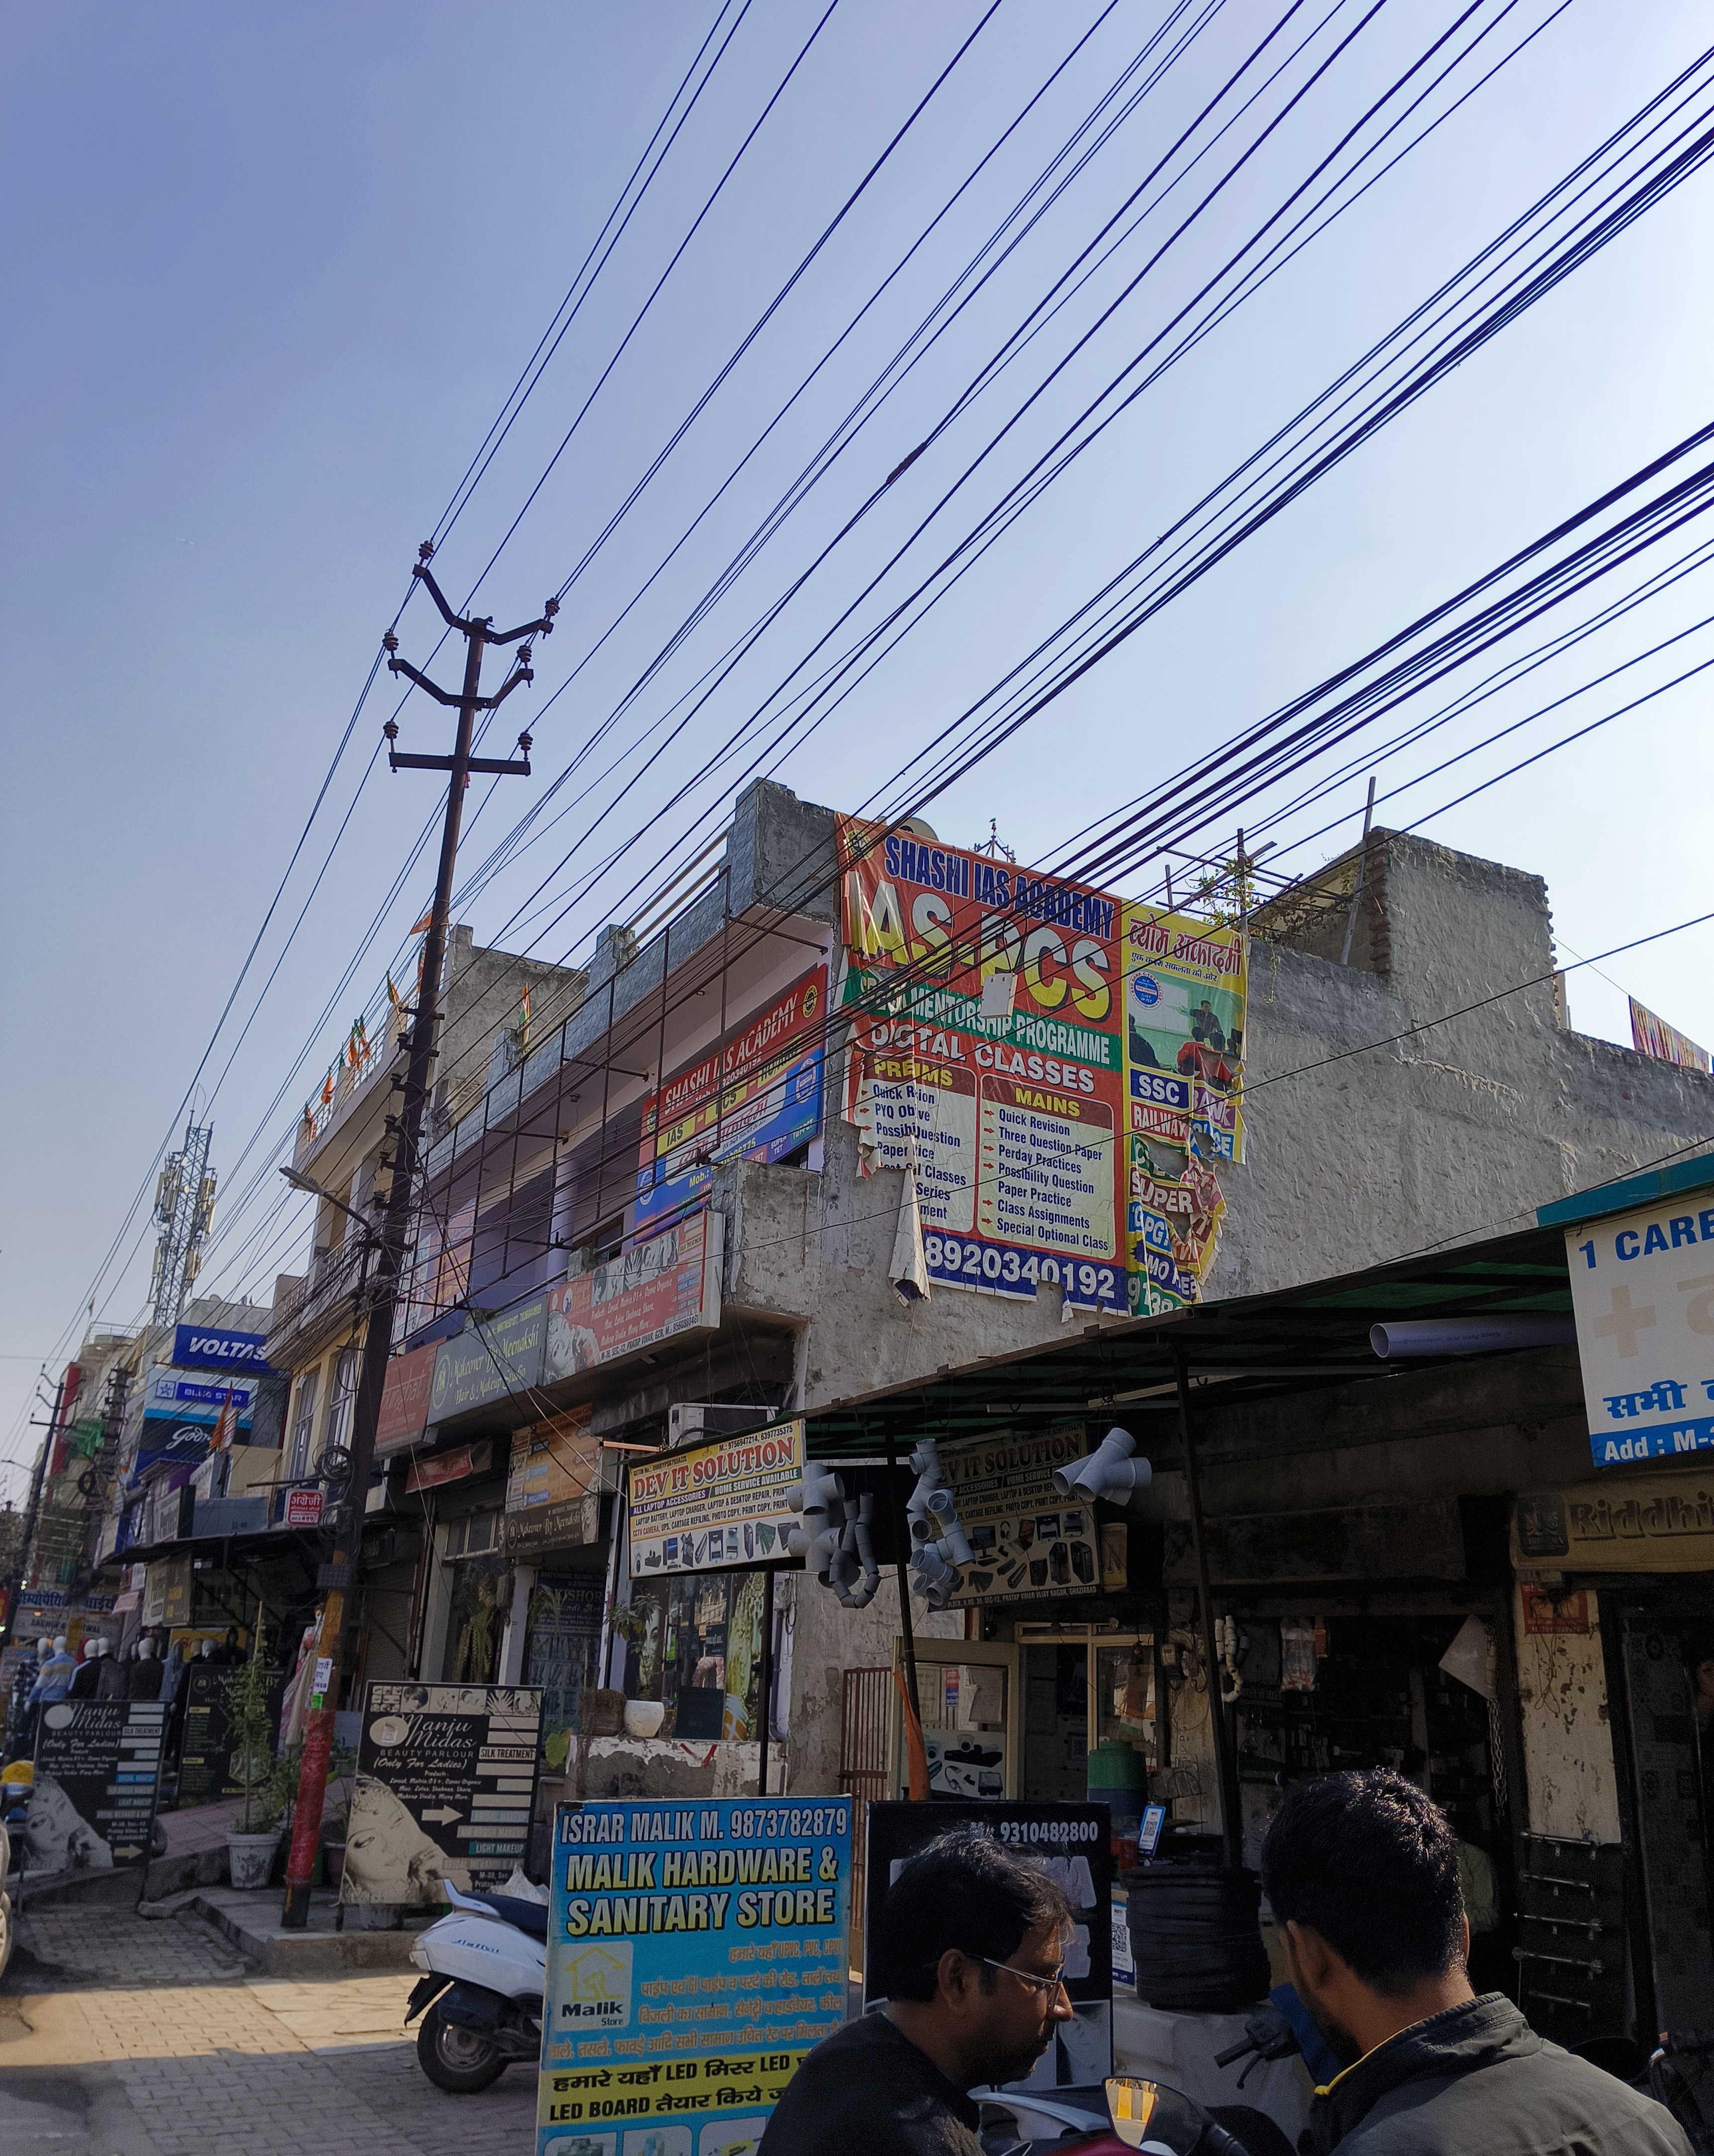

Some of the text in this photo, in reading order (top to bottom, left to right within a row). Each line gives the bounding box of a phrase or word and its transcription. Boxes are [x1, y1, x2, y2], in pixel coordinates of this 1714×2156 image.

[885, 835, 968, 899] SHASHI
[973, 862, 1011, 910] IAS
[1015, 875, 1114, 941] ACADEMY
[735, 993, 798, 1067] ACADEMY
[1016, 1014, 1110, 1066] PROGRAMME
[975, 1041, 1094, 1095] CLASSES
[1015, 1087, 1080, 1117] MAINS
[1139, 1074, 1180, 1104] SSC
[875, 1103, 894, 1120] PYQ
[999, 1109, 1070, 1137] Quick Revision
[666, 1124, 684, 1147] IAS
[999, 1126, 1102, 1161] Three Question Paper
[999, 1144, 1081, 1174] Perday Practices
[924, 1165, 966, 1186] Classes
[999, 1162, 1094, 1195] Possibility Question
[916, 1182, 950, 1201] Series
[998, 1180, 1071, 1208] Paper Practice
[998, 1199, 1090, 1230] Class Assignments
[997, 1218, 1108, 1251] Special Optional Class
[926, 1236, 1116, 1299] 8920340192
[189, 1337, 267, 1361] VOLTAS
[1602, 1379, 1688, 1419] सभी
[984, 1434, 1081, 1476] SOLUTION
[1604, 1436, 1648, 1462] Add
[633, 1471, 669, 1503] DEV
[671, 1465, 691, 1493] IT
[692, 1436, 795, 1488] SOLUTION
[715, 1469, 798, 1495] HOME SERVICE AVAILABLE
[633, 1490, 706, 1515] ALL LAPTOP ACCESSORIES
[708, 1499, 724, 1510] LAPTOP
[730, 1494, 751, 1506] DESKTOP
[712, 1511, 726, 1521] PHOTO
[742, 1504, 756, 1515] PRINT
[1569, 1491, 1714, 1535] Riddhi
[380, 1749, 474, 1758] BEAUTY PARLOUR
[480, 1748, 534, 1759] SILK TREATMENT
[561, 1807, 847, 1844] ISRAR MALIK M. 9873782879
[1000, 1821, 1098, 1842] 9310482800
[476, 1842, 524, 1854] LIGHT MAKEUP
[566, 1844, 839, 1892] MALIK HARDWARE &
[566, 1888, 835, 1937] SANITARY STORE
[562, 2002, 624, 2018] Malik
[601, 2017, 624, 2027] Store
[552, 2069, 614, 2092] हमारे
[665, 2062, 697, 2081] LED
[760, 2054, 791, 2072] LED
[550, 2103, 583, 2121] LED
[589, 2097, 650, 2118] BOARD
